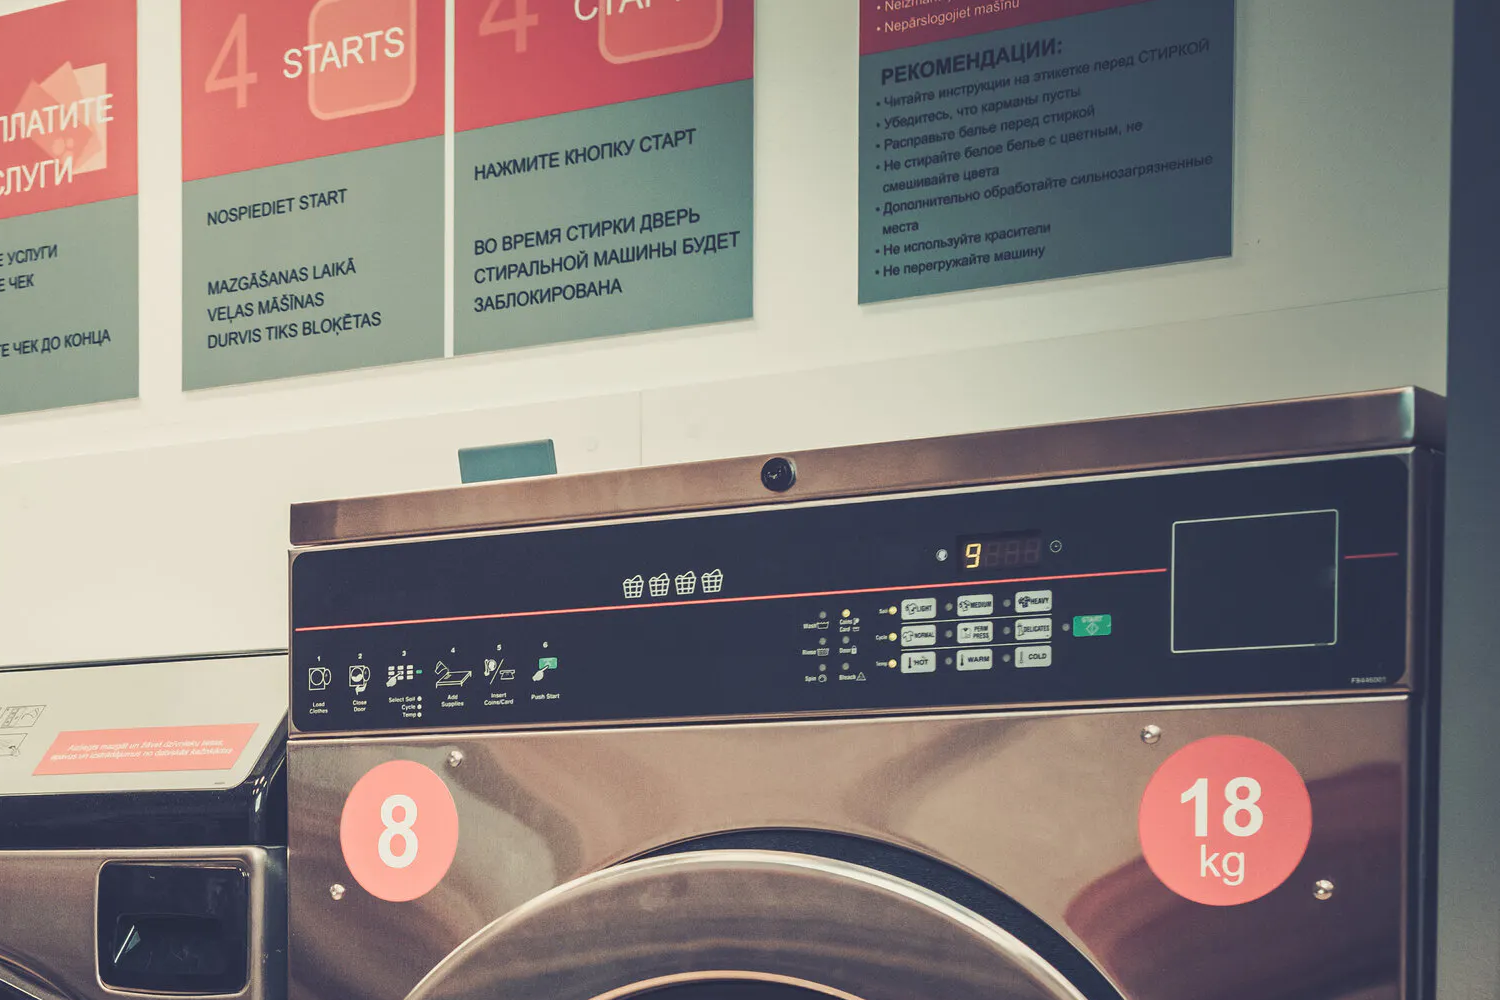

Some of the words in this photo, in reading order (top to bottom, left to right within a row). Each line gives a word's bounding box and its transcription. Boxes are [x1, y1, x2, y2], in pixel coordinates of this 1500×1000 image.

[884, 7, 970, 33] Nepārslogojiet
[204, 14, 258, 109] 4
[283, 27, 405, 79] STARTS
[881, 38, 1063, 85] РЕКОМЕНДАЦИИ:
[884, 90, 935, 107] Читайте
[939, 78, 1010, 99] инструкции
[1015, 76, 1029, 85] на
[1034, 62, 1090, 82] этикетке
[1094, 54, 1134, 73] перед
[1138, 38, 1210, 63] СТИРКОЙ
[957, 104, 977, 116] что
[982, 94, 1038, 114] карманы
[1043, 87, 1081, 105] пусты
[884, 131, 955, 151] Расправьте
[959, 124, 996, 139] белье
[1001, 116, 1039, 132] перед
[1043, 105, 1095, 125] стиркой
[884, 159, 901, 171] Не
[905, 150, 961, 168] стирайте
[965, 143, 1003, 158] белое
[1007, 137, 1045, 152] белье
[1049, 135, 1056, 145] с
[1126, 121, 1143, 132] не
[474, 152, 560, 181] НАЖМИТЕ
[565, 139, 635, 165] КНОПКУ
[640, 128, 697, 152] СТАРТ
[883, 172, 959, 193] смешивайте
[964, 166, 1000, 182] цвета
[883, 190, 980, 216] Дополнительно
[984, 176, 1067, 200] обработайте
[1071, 153, 1213, 186] сильнозагрязненные
[207, 198, 295, 226] NOSPIEDIET
[299, 189, 348, 210] START
[475, 238, 497, 255] ВО
[503, 228, 561, 251] ВРЕМЯ
[566, 217, 635, 243] СТИРКИ
[640, 208, 700, 233] ДВЕРЬ
[882, 221, 919, 234] места
[884, 244, 900, 256] Не
[904, 234, 981, 253] используйте
[985, 223, 1051, 243] красители
[7, 244, 58, 266] УСЛУГИ
[474, 251, 589, 284] СТИРАЛЬНОЙ
[594, 240, 676, 267] МАШИНЫ
[683, 231, 741, 255] БУДЕТ
[883, 265, 900, 277] Не
[904, 252, 990, 274] перегружайте
[994, 246, 1045, 262] машину
[8, 274, 34, 289] ЧЕК
[208, 266, 308, 295] MAZGĀŠANAS
[313, 258, 356, 280] LAIKĀ
[474, 278, 622, 312] ЗАБЛОКИРОВАНА
[207, 302, 254, 323] VEĻAS
[208, 328, 261, 349] DURVIS
[266, 323, 298, 341] TIKS
[302, 311, 382, 336] BLOĶĒTAS
[13, 339, 38, 354] ЧЕК
[41, 336, 61, 354] ДО
[65, 329, 111, 348] КОНЦА
[965, 542, 982, 569] 9
[916, 605, 932, 613] LIGHT
[1030, 597, 1050, 605] HEAVY
[1023, 625, 1050, 633] DELICATES
[1181, 777, 1263, 837] 18
[378, 794, 418, 868] 8
[1200, 844, 1245, 886] kg
